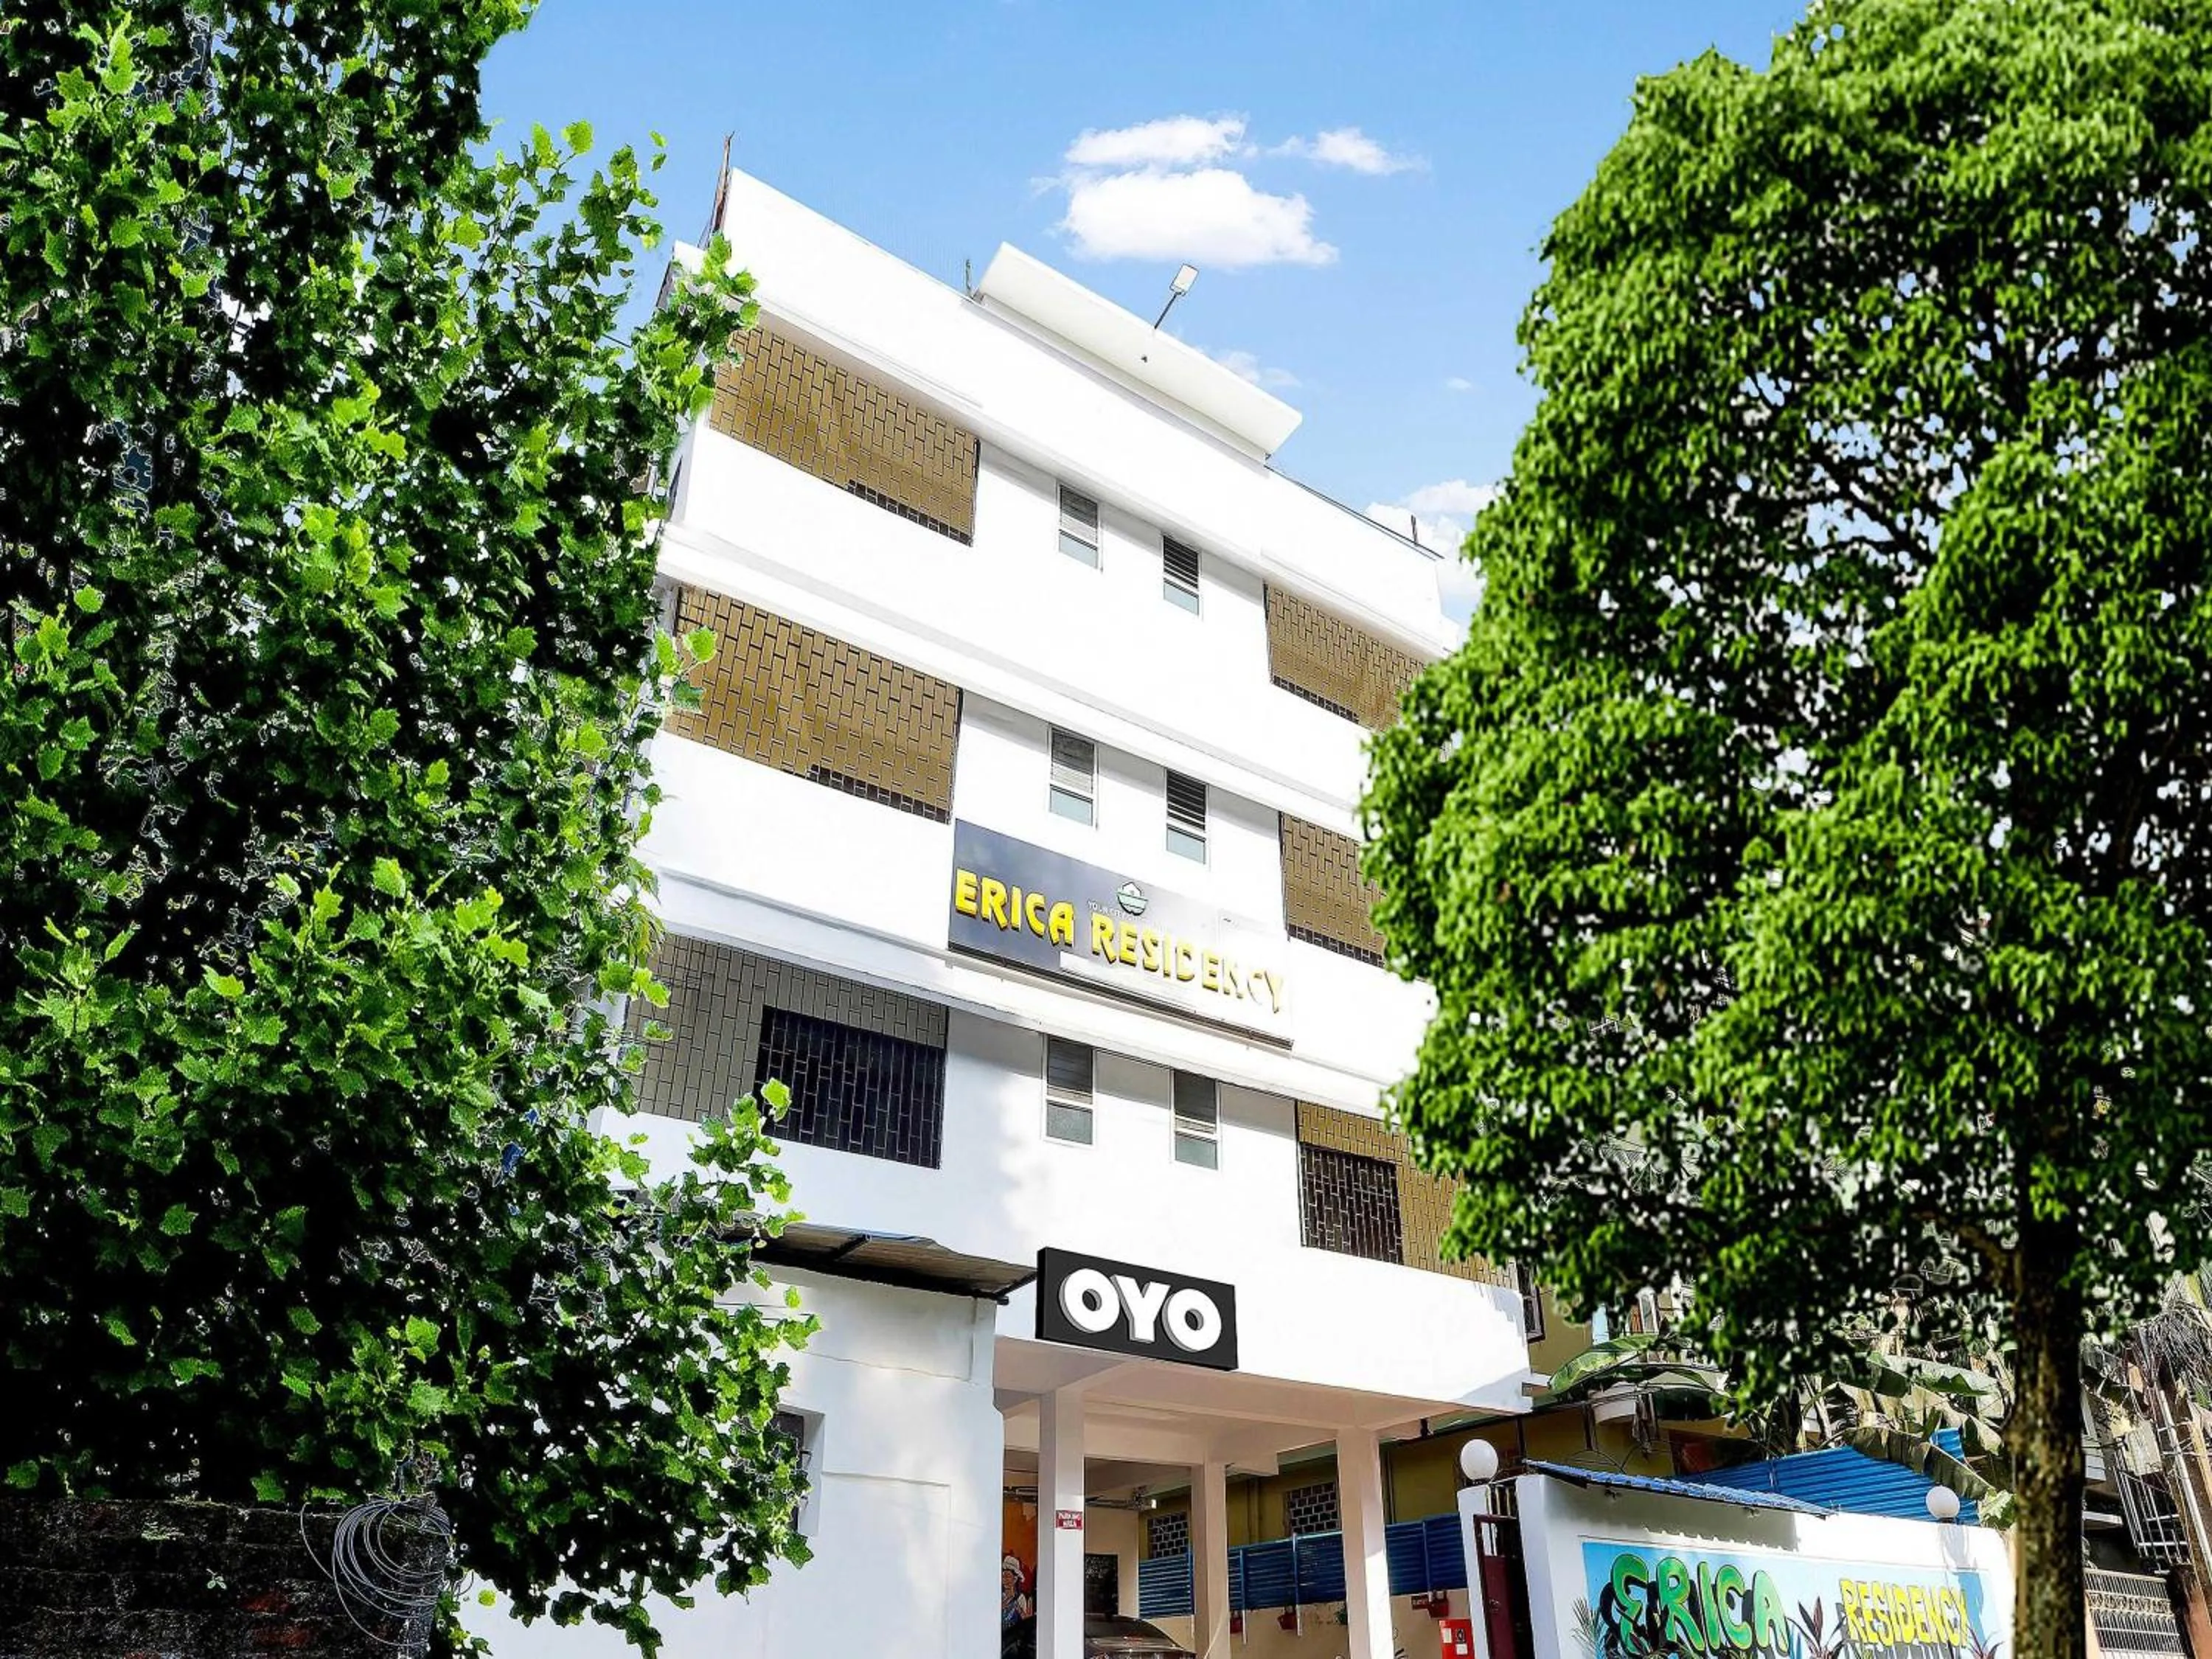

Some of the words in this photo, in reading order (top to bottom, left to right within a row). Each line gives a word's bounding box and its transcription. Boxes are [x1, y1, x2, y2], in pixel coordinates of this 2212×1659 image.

[956, 869, 1074, 947] ERICA
[1058, 1267, 1222, 1352] OYO
[1610, 1554, 1790, 1657] ERICA
[1839, 1579, 1969, 1648] RESIDENCY
